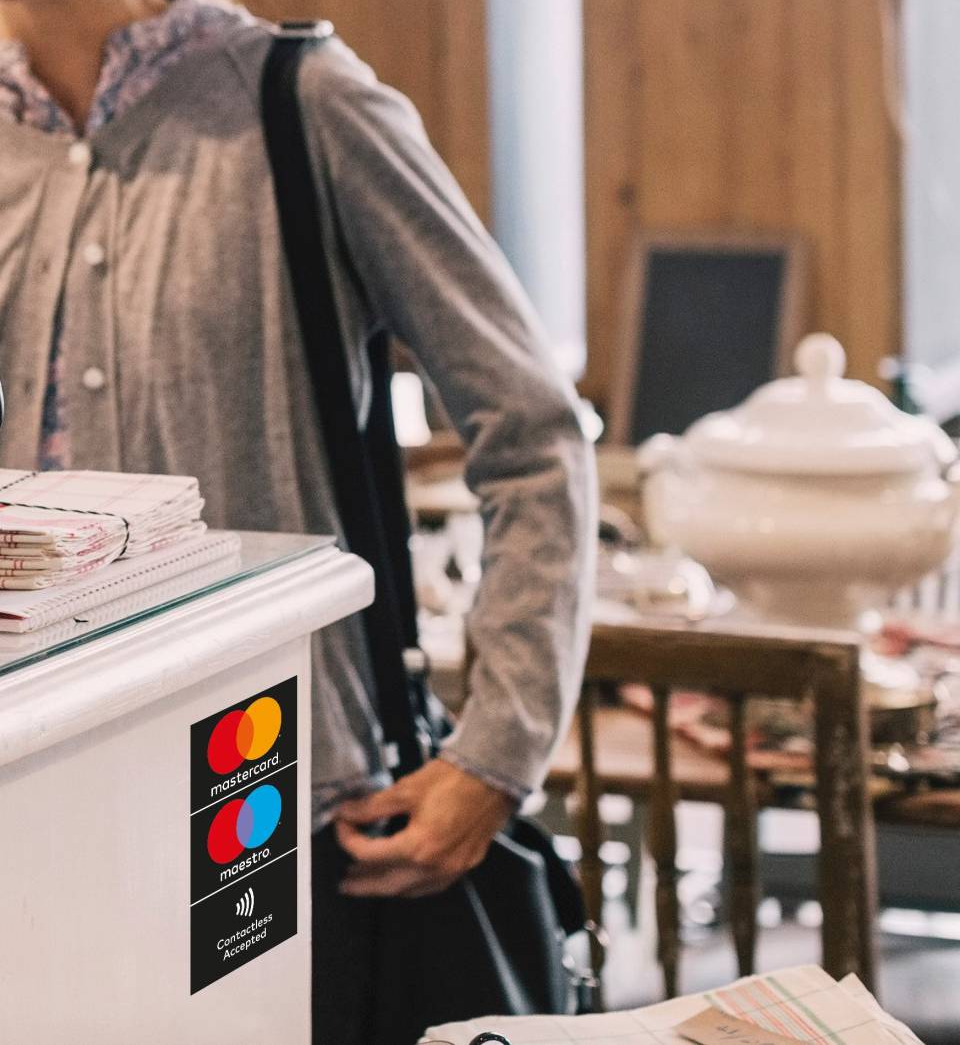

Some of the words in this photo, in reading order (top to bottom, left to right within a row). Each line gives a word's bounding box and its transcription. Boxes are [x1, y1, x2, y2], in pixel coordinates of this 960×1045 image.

[210, 752, 279, 797] mastercard
[220, 848, 270, 882] maestro
[216, 913, 273, 950] Contactless
[223, 927, 267, 961] Accepted
